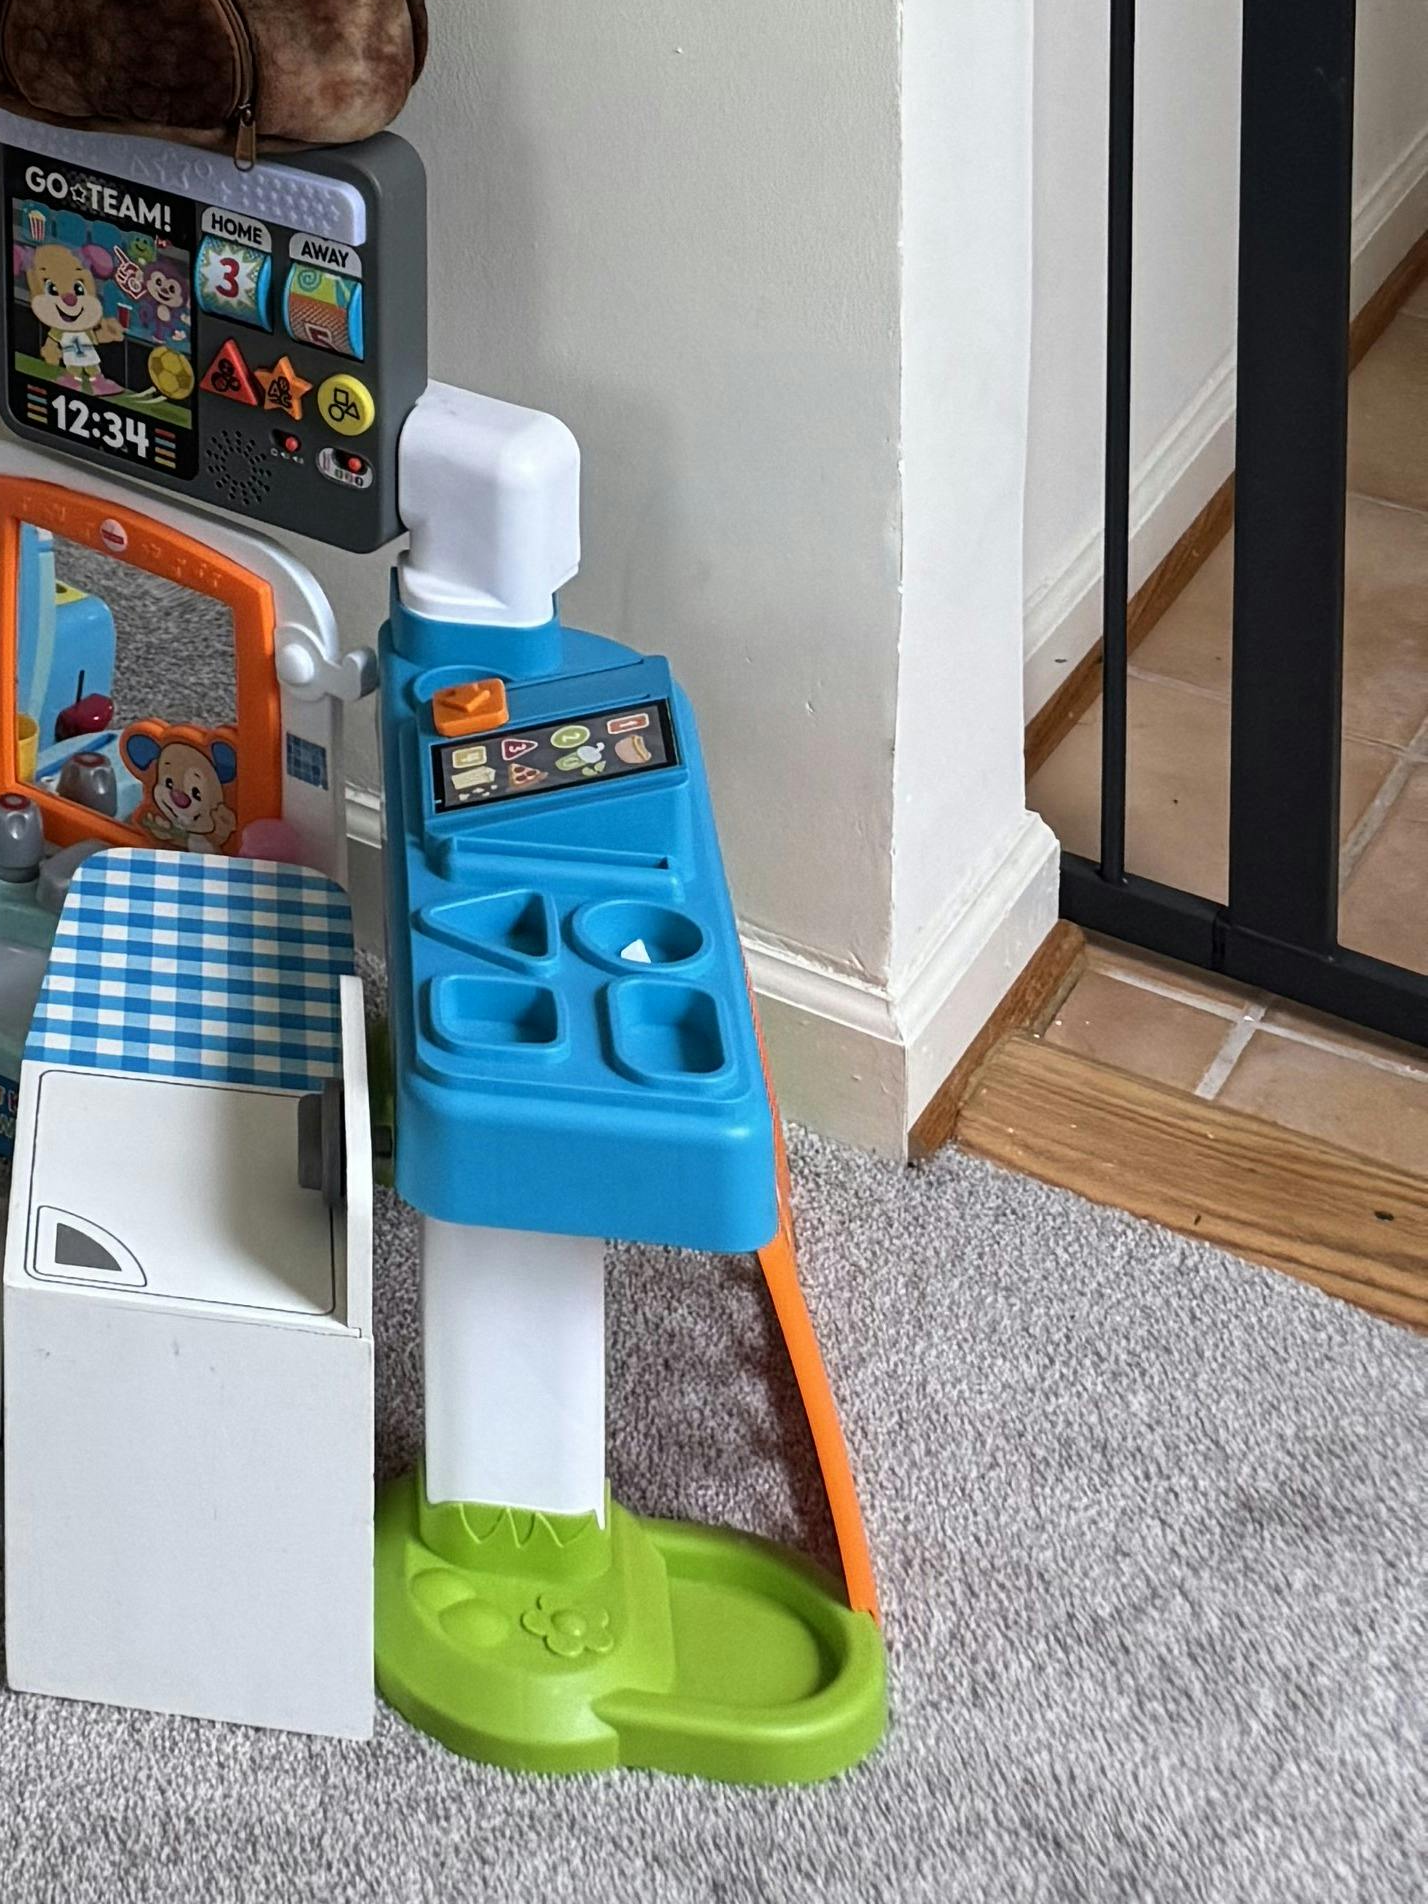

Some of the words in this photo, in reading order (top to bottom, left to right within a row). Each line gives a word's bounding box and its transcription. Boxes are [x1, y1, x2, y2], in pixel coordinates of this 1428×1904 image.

[25, 165, 69, 199] GO
[87, 184, 173, 233] TEAM!
[211, 212, 263, 246] HOME
[300, 239, 349, 268] AWAY
[215, 257, 240, 299] 3
[51, 394, 150, 458] 12:34
